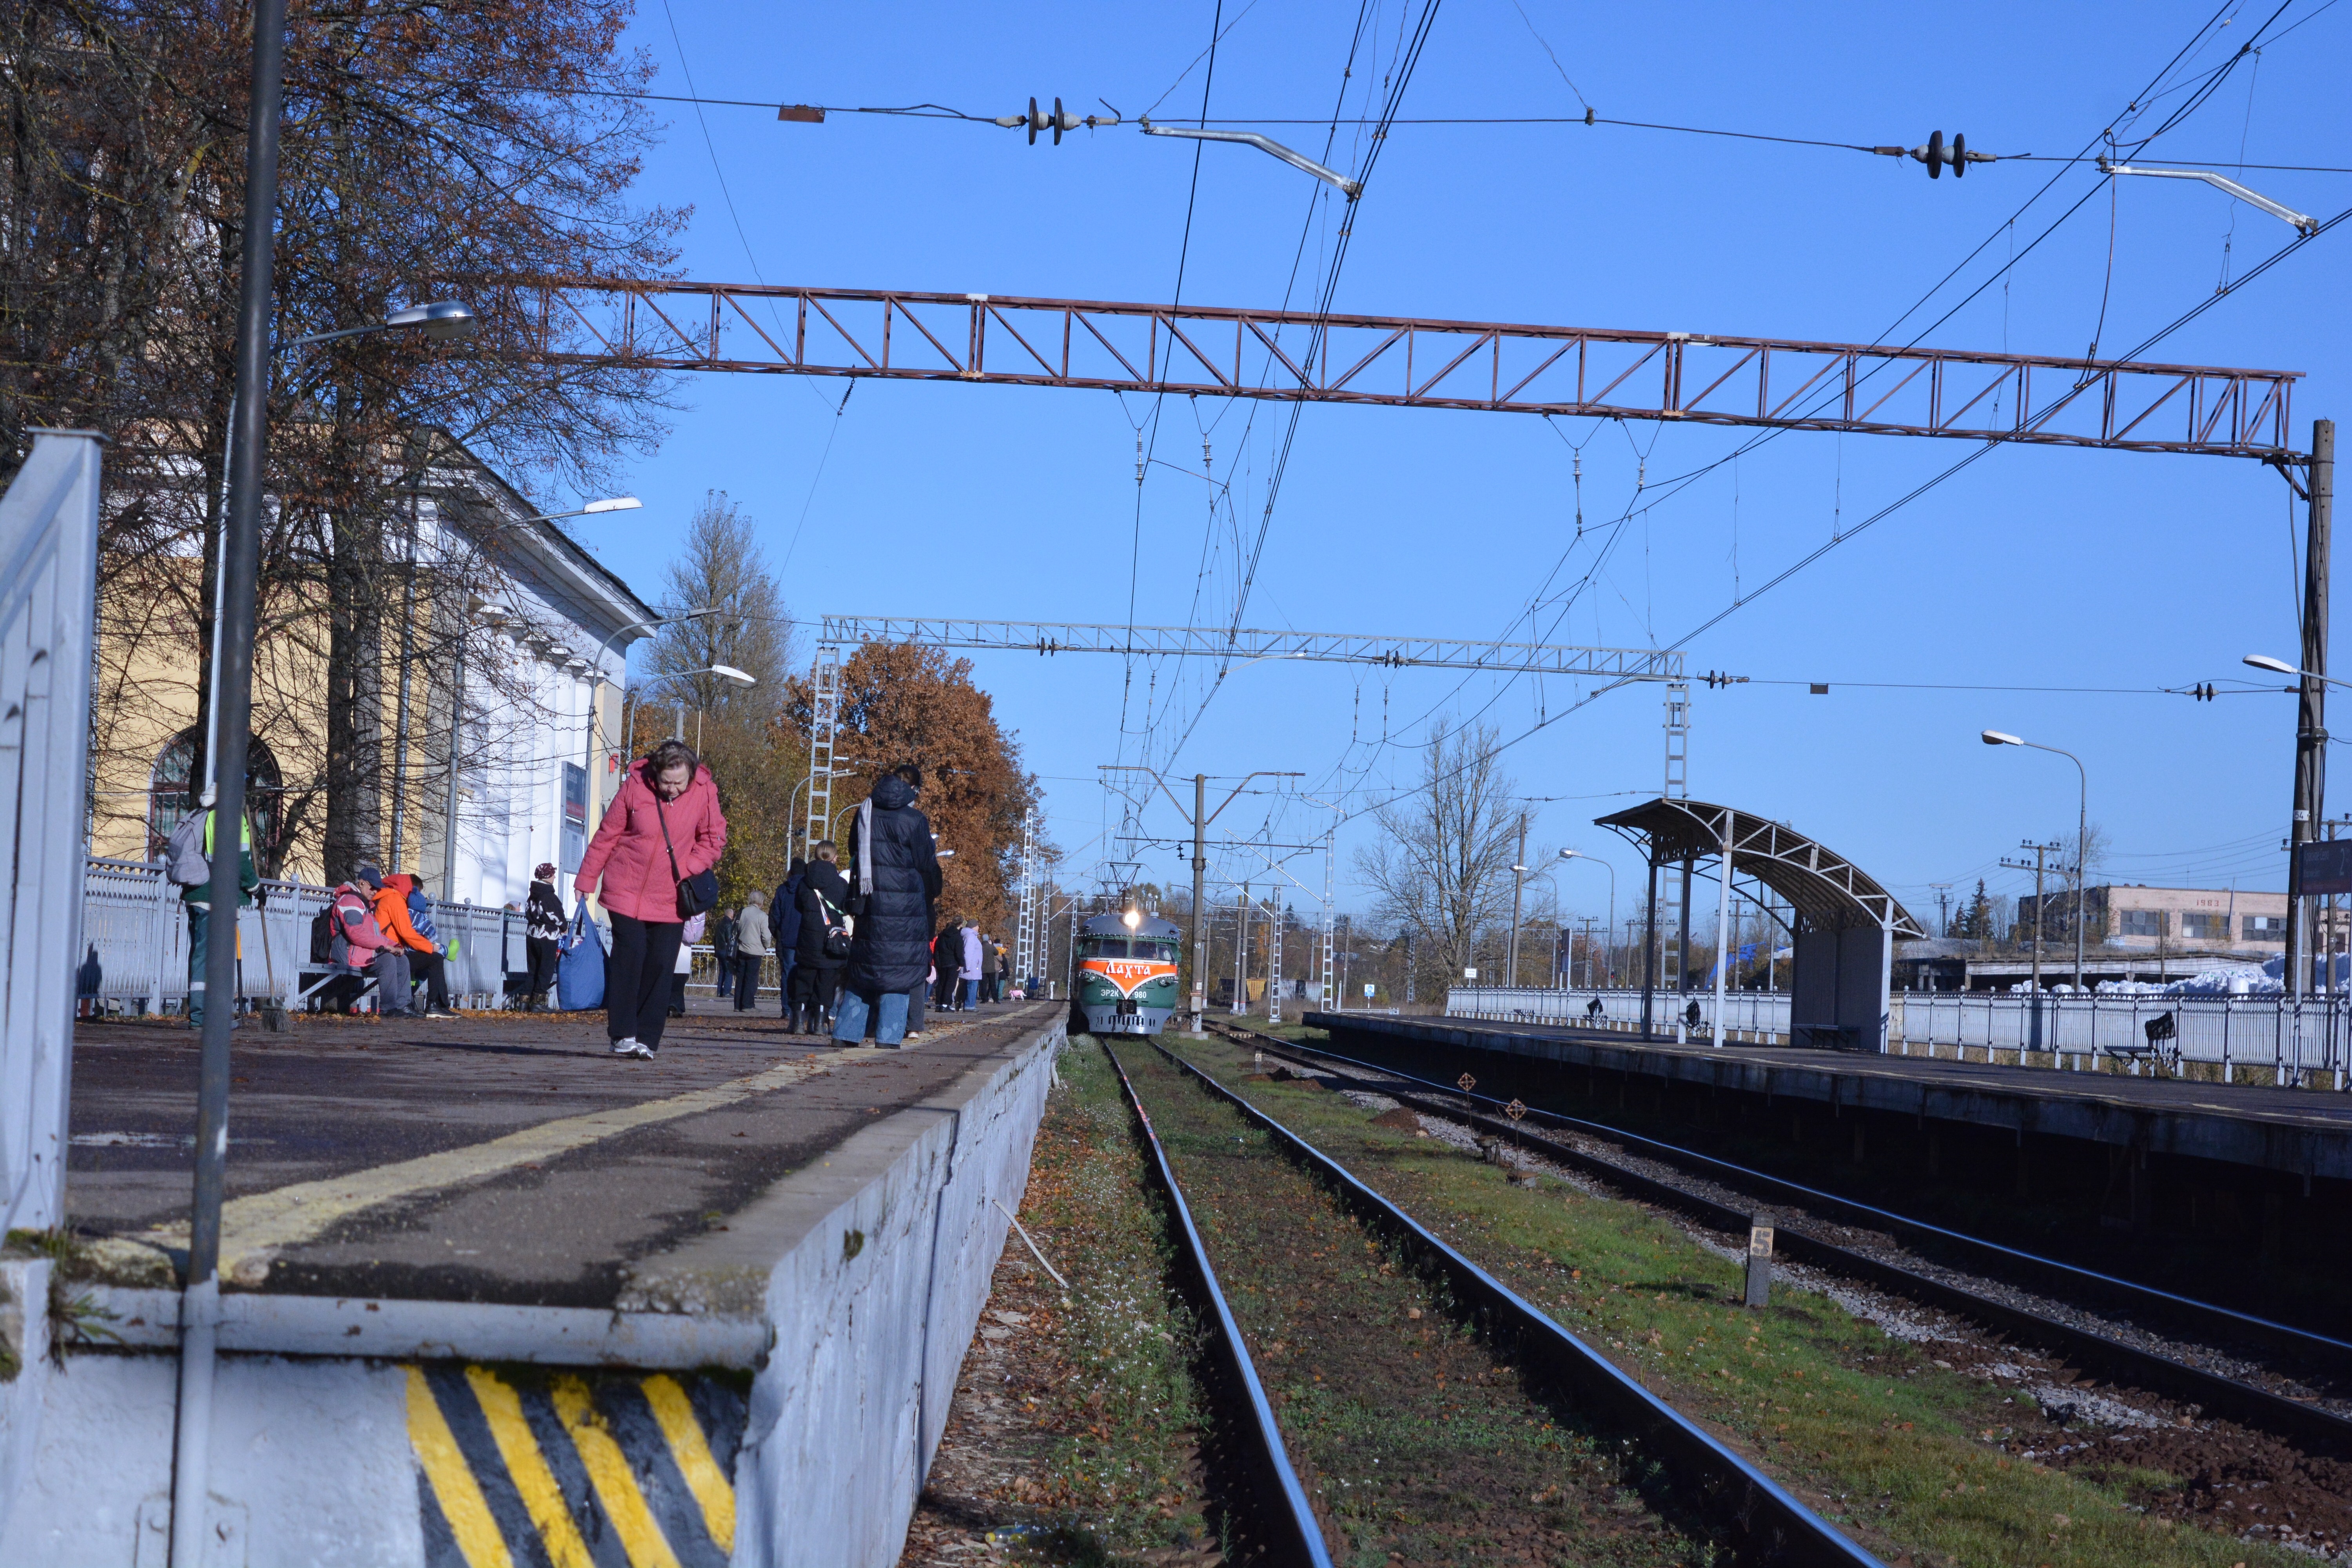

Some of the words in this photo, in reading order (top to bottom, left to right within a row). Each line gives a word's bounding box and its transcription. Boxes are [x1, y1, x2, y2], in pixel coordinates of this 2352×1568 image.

[1105, 960, 1151, 978] Лахта
[1101, 989, 1119, 997] ЭР2К
[1752, 1230, 1770, 1255] 5
